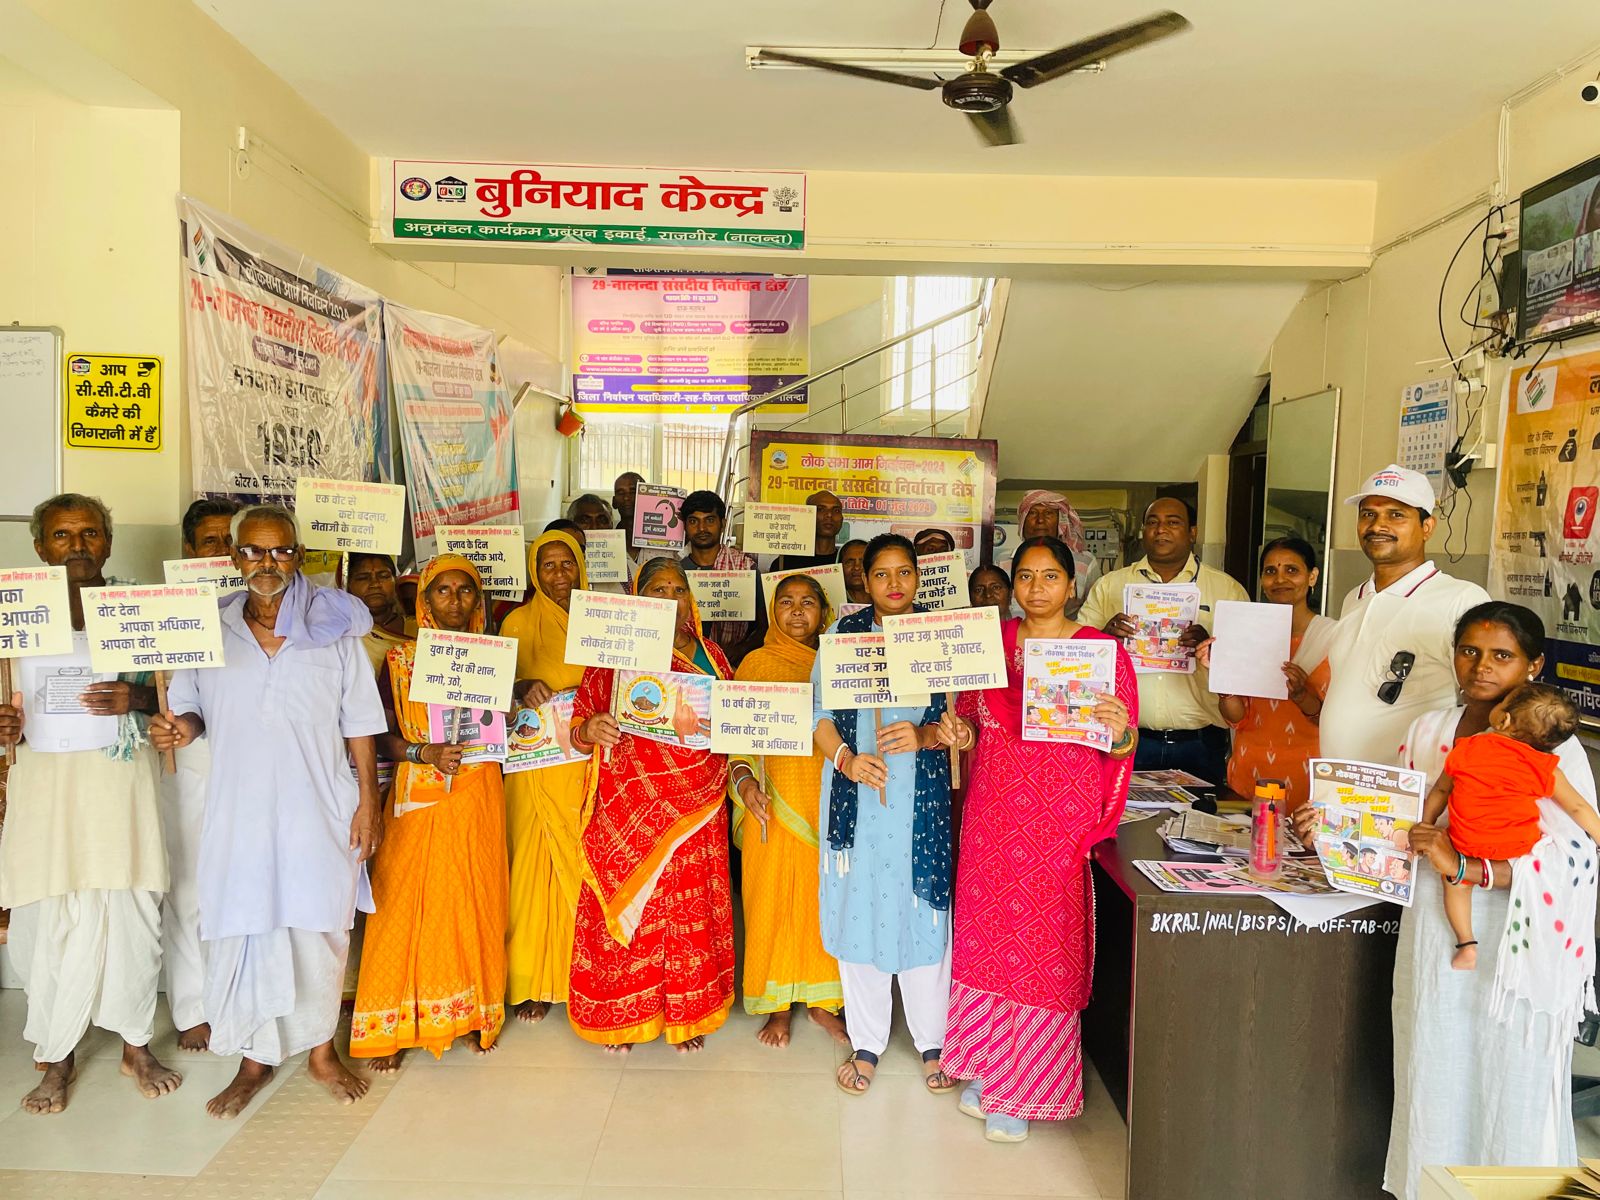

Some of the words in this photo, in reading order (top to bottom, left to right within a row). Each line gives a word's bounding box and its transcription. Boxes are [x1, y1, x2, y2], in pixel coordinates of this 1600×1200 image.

[475, 170, 648, 218] बुनियाद
[660, 176, 768, 217] केन्द्र
[404, 222, 472, 236] अनुमंडल
[478, 223, 541, 236] कार्यक्रम
[547, 225, 597, 238] प्रबंधन
[603, 227, 650, 242] इकाई,
[658, 229, 717, 241] राजगीर
[724, 233, 793, 246] (नालन्दा)
[592, 280, 659, 291] 29-नालन्दा
[661, 278, 709, 291] संसदीय
[712, 278, 761, 292] निर्वाचन
[765, 278, 788, 292] क्षेत्र
[100, 364, 127, 376] आप
[76, 380, 151, 398] सी.सी.टी.वी
[577, 392, 600, 402] जिला
[603, 391, 635, 402] निर्वाचन
[85, 402, 119, 418] कैमरे
[122, 403, 141, 419] की
[71, 423, 125, 440] निगरानी
[129, 425, 143, 441] में
[801, 452, 824, 468] लोक
[828, 454, 850, 469] सभा
[852, 457, 873, 470] आम
[767, 475, 838, 492] 29-नालन्दा
[841, 475, 894, 495] संसदीय
[895, 477, 947, 497] निर्वाचन
[951, 479, 976, 498] क्षेत्र
[315, 494, 329, 503] एक
[331, 493, 345, 505] वोट
[347, 494, 357, 505] से
[875, 499, 888, 511] 01
[888, 501, 907, 515] जून
[338, 508, 355, 519] करो
[357, 510, 388, 523] बदलाव,
[311, 520, 339, 533] नेताजी
[341, 521, 350, 533] के
[351, 523, 374, 535] बदलो
[337, 537, 374, 549] हाव-भाव
[446, 540, 466, 551] चुनाव
[466, 539, 473, 549] के
[474, 538, 488, 549] दिन
[489, 551, 506, 562] आये,
[476, 565, 492, 573] पना
[938, 565, 950, 573] का
[219, 575, 228, 588] में
[494, 575, 513, 586] बनाये
[921, 576, 951, 588] आधार,
[929, 586, 946, 597] कोई
[947, 584, 957, 595] हो
[2, 605, 50, 626] आपकी
[97, 603, 116, 617] वोट
[118, 602, 140, 616] देना
[585, 607, 612, 619] आपका
[613, 608, 628, 621] वोट
[630, 609, 637, 622] है
[120, 620, 154, 632] आपका
[158, 617, 205, 632] अधिकार,
[604, 624, 633, 637] आपकी
[634, 628, 661, 640] ताकत,
[16, 630, 29, 648] है
[893, 632, 914, 643] अगर
[916, 630, 933, 642] उम्र
[934, 625, 964, 640] आपकी
[100, 638, 135, 651] आपका
[137, 635, 156, 649] वोट
[580, 635, 613, 649] लोकतंत्र
[614, 638, 626, 651] की
[628, 638, 635, 652] है
[941, 642, 950, 655] है
[951, 642, 985, 655] अठारह,
[132, 650, 163, 665] बनाये
[166, 652, 205, 664] सरकार
[430, 644, 444, 656] युवा
[445, 646, 454, 656] हो
[455, 647, 468, 659] तुम
[598, 651, 605, 664] ये
[450, 660, 463, 672] देश
[465, 662, 476, 674] की
[477, 666, 496, 677] शान,
[835, 662, 870, 673] अलख
[910, 660, 932, 674] वोटर
[934, 657, 953, 671] कार्ड
[426, 673, 446, 686] जागो,
[447, 675, 462, 688] उठो,
[830, 678, 873, 689] मतदाता
[953, 673, 990, 686] बनवाना
[446, 690, 463, 701] करो
[463, 693, 493, 705] मतदान
[733, 697, 744, 709] वर्ष
[745, 697, 756, 709] की
[757, 700, 770, 710] उम्र
[753, 713, 767, 723] कर
[768, 711, 779, 723] ली
[781, 714, 798, 726] पार,
[720, 722, 741, 735] मिला
[743, 723, 756, 736] वोट
[758, 726, 769, 736] का
[751, 739, 764, 749] अब
[766, 737, 798, 751] अधिकार
